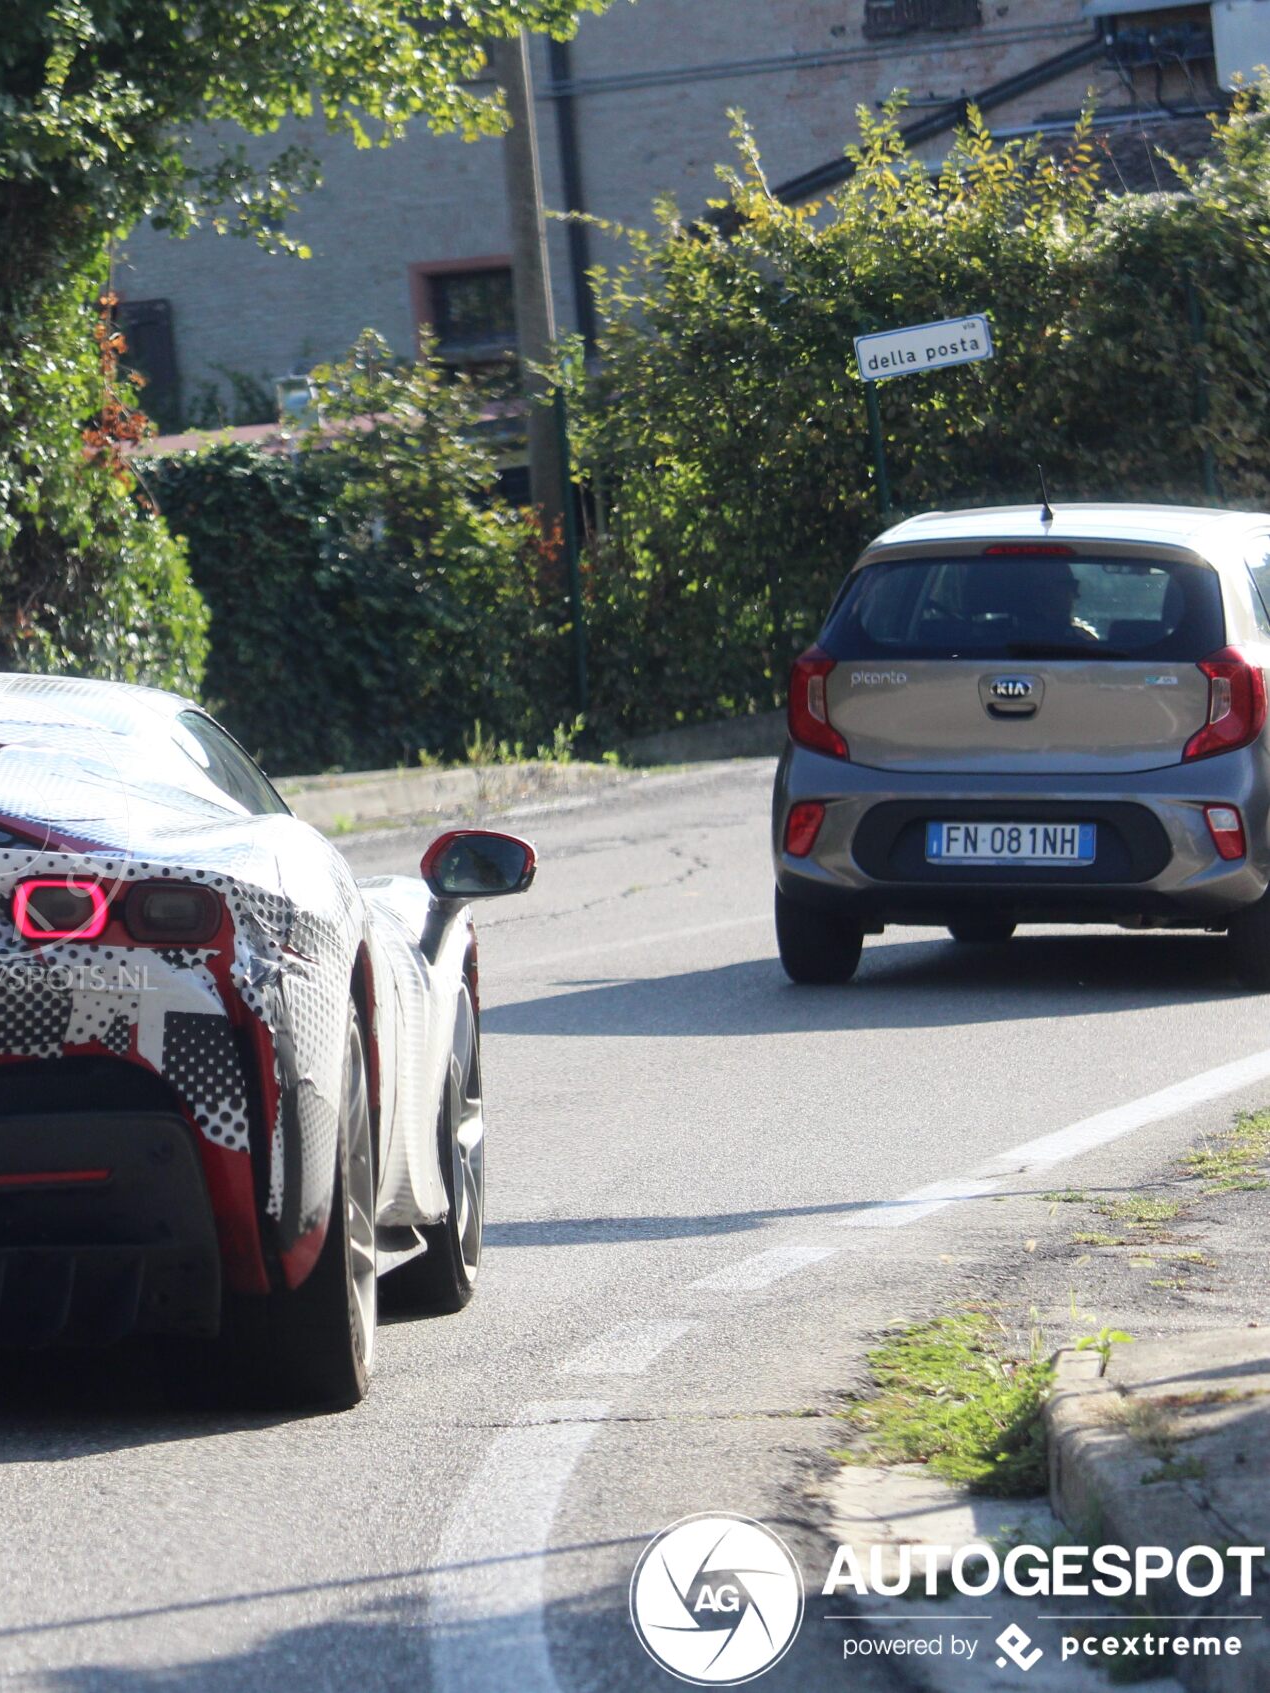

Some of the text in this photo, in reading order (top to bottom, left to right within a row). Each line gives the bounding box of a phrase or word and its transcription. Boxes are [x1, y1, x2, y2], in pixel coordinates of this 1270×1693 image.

[962, 321, 976, 331] via
[868, 337, 979, 371] della posta
[850, 669, 907, 688] picanto
[996, 681, 1026, 696] KIA
[945, 826, 978, 854] FN
[990, 826, 1076, 855] 081NH
